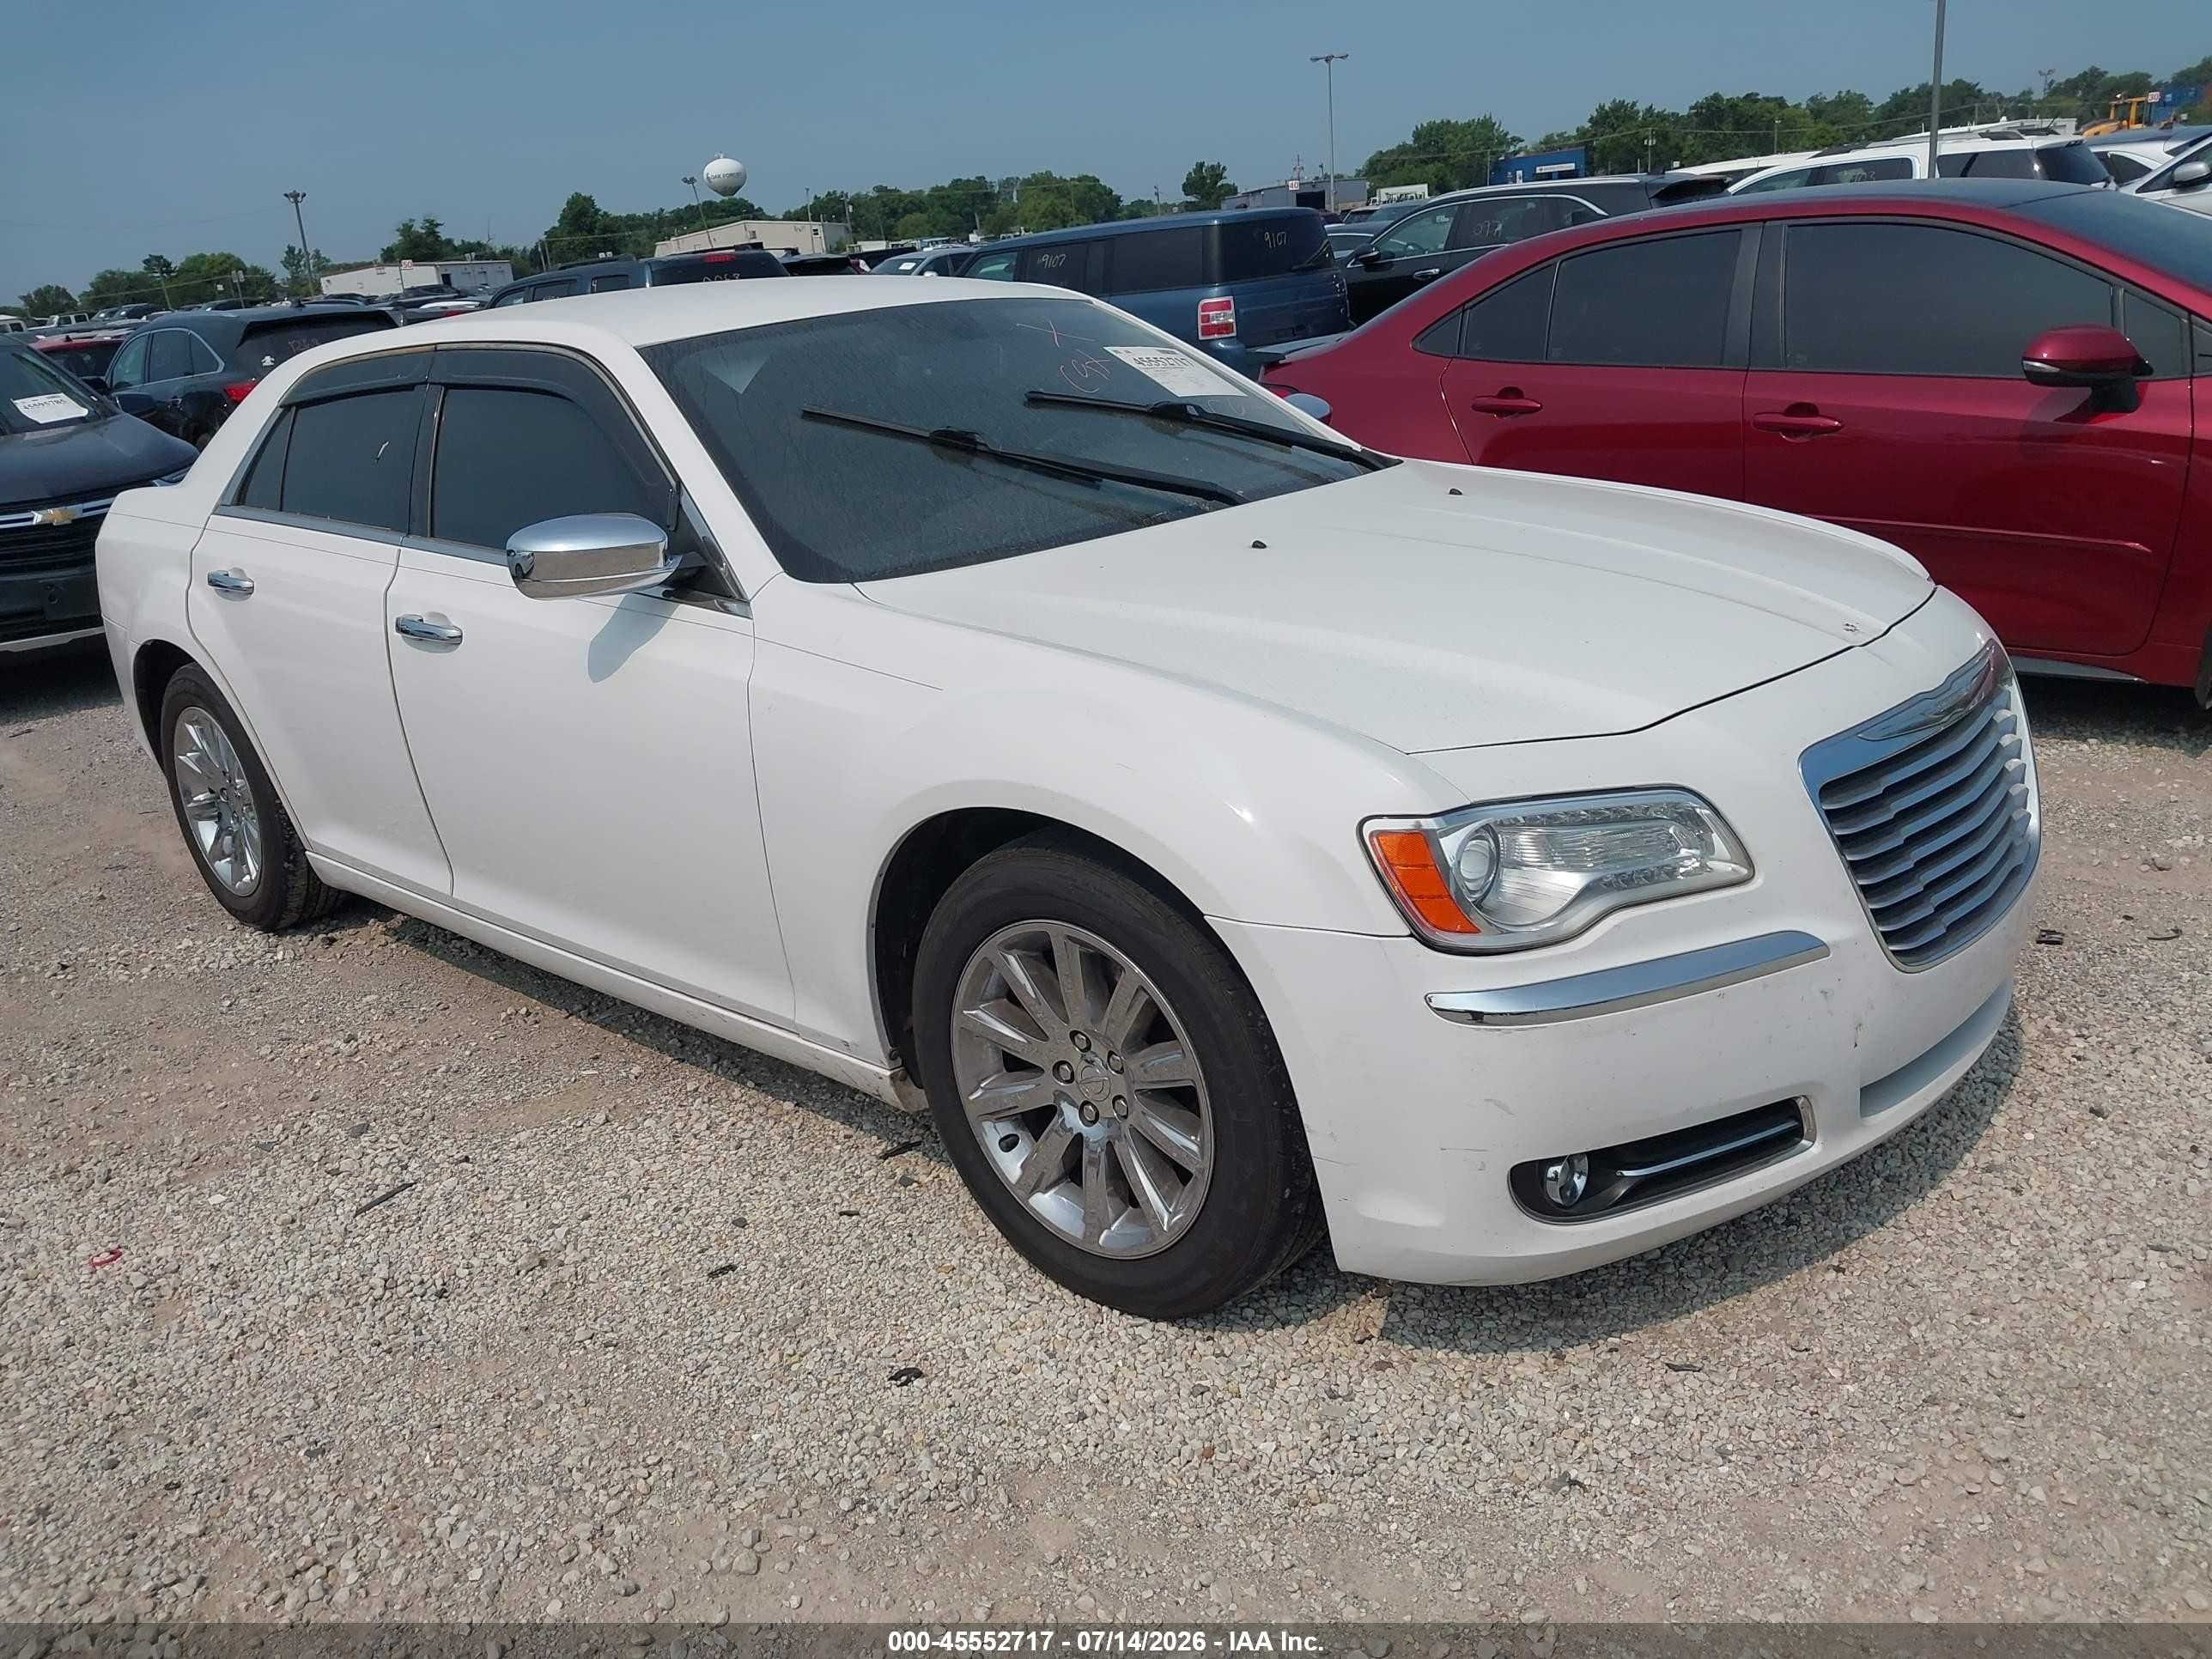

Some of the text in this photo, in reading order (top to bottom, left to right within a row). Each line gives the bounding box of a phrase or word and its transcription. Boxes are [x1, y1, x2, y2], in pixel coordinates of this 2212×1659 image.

[1289, 180, 1299, 189] 40
[1264, 231, 1287, 248] 9107
[402, 260, 412, 269] 50
[1042, 253, 1066, 269] 9107
[1133, 356, 1195, 368] 45552717
